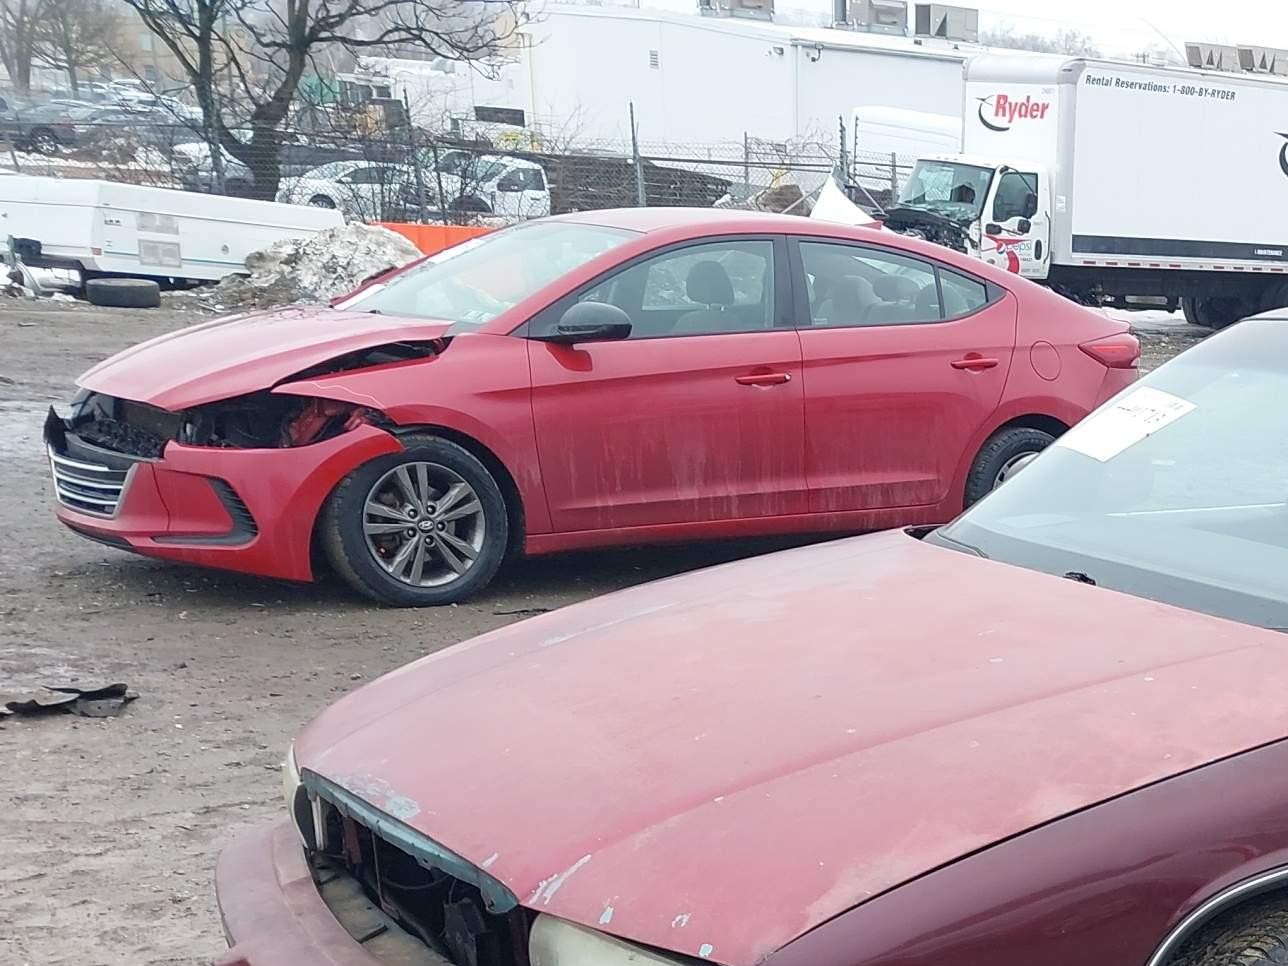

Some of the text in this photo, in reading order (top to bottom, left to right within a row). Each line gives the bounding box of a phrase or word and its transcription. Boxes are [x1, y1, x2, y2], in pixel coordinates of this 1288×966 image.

[1085, 74, 1236, 101] Rental Reservations: 1-800-BY-RYDER
[994, 94, 1050, 124] Ryder
